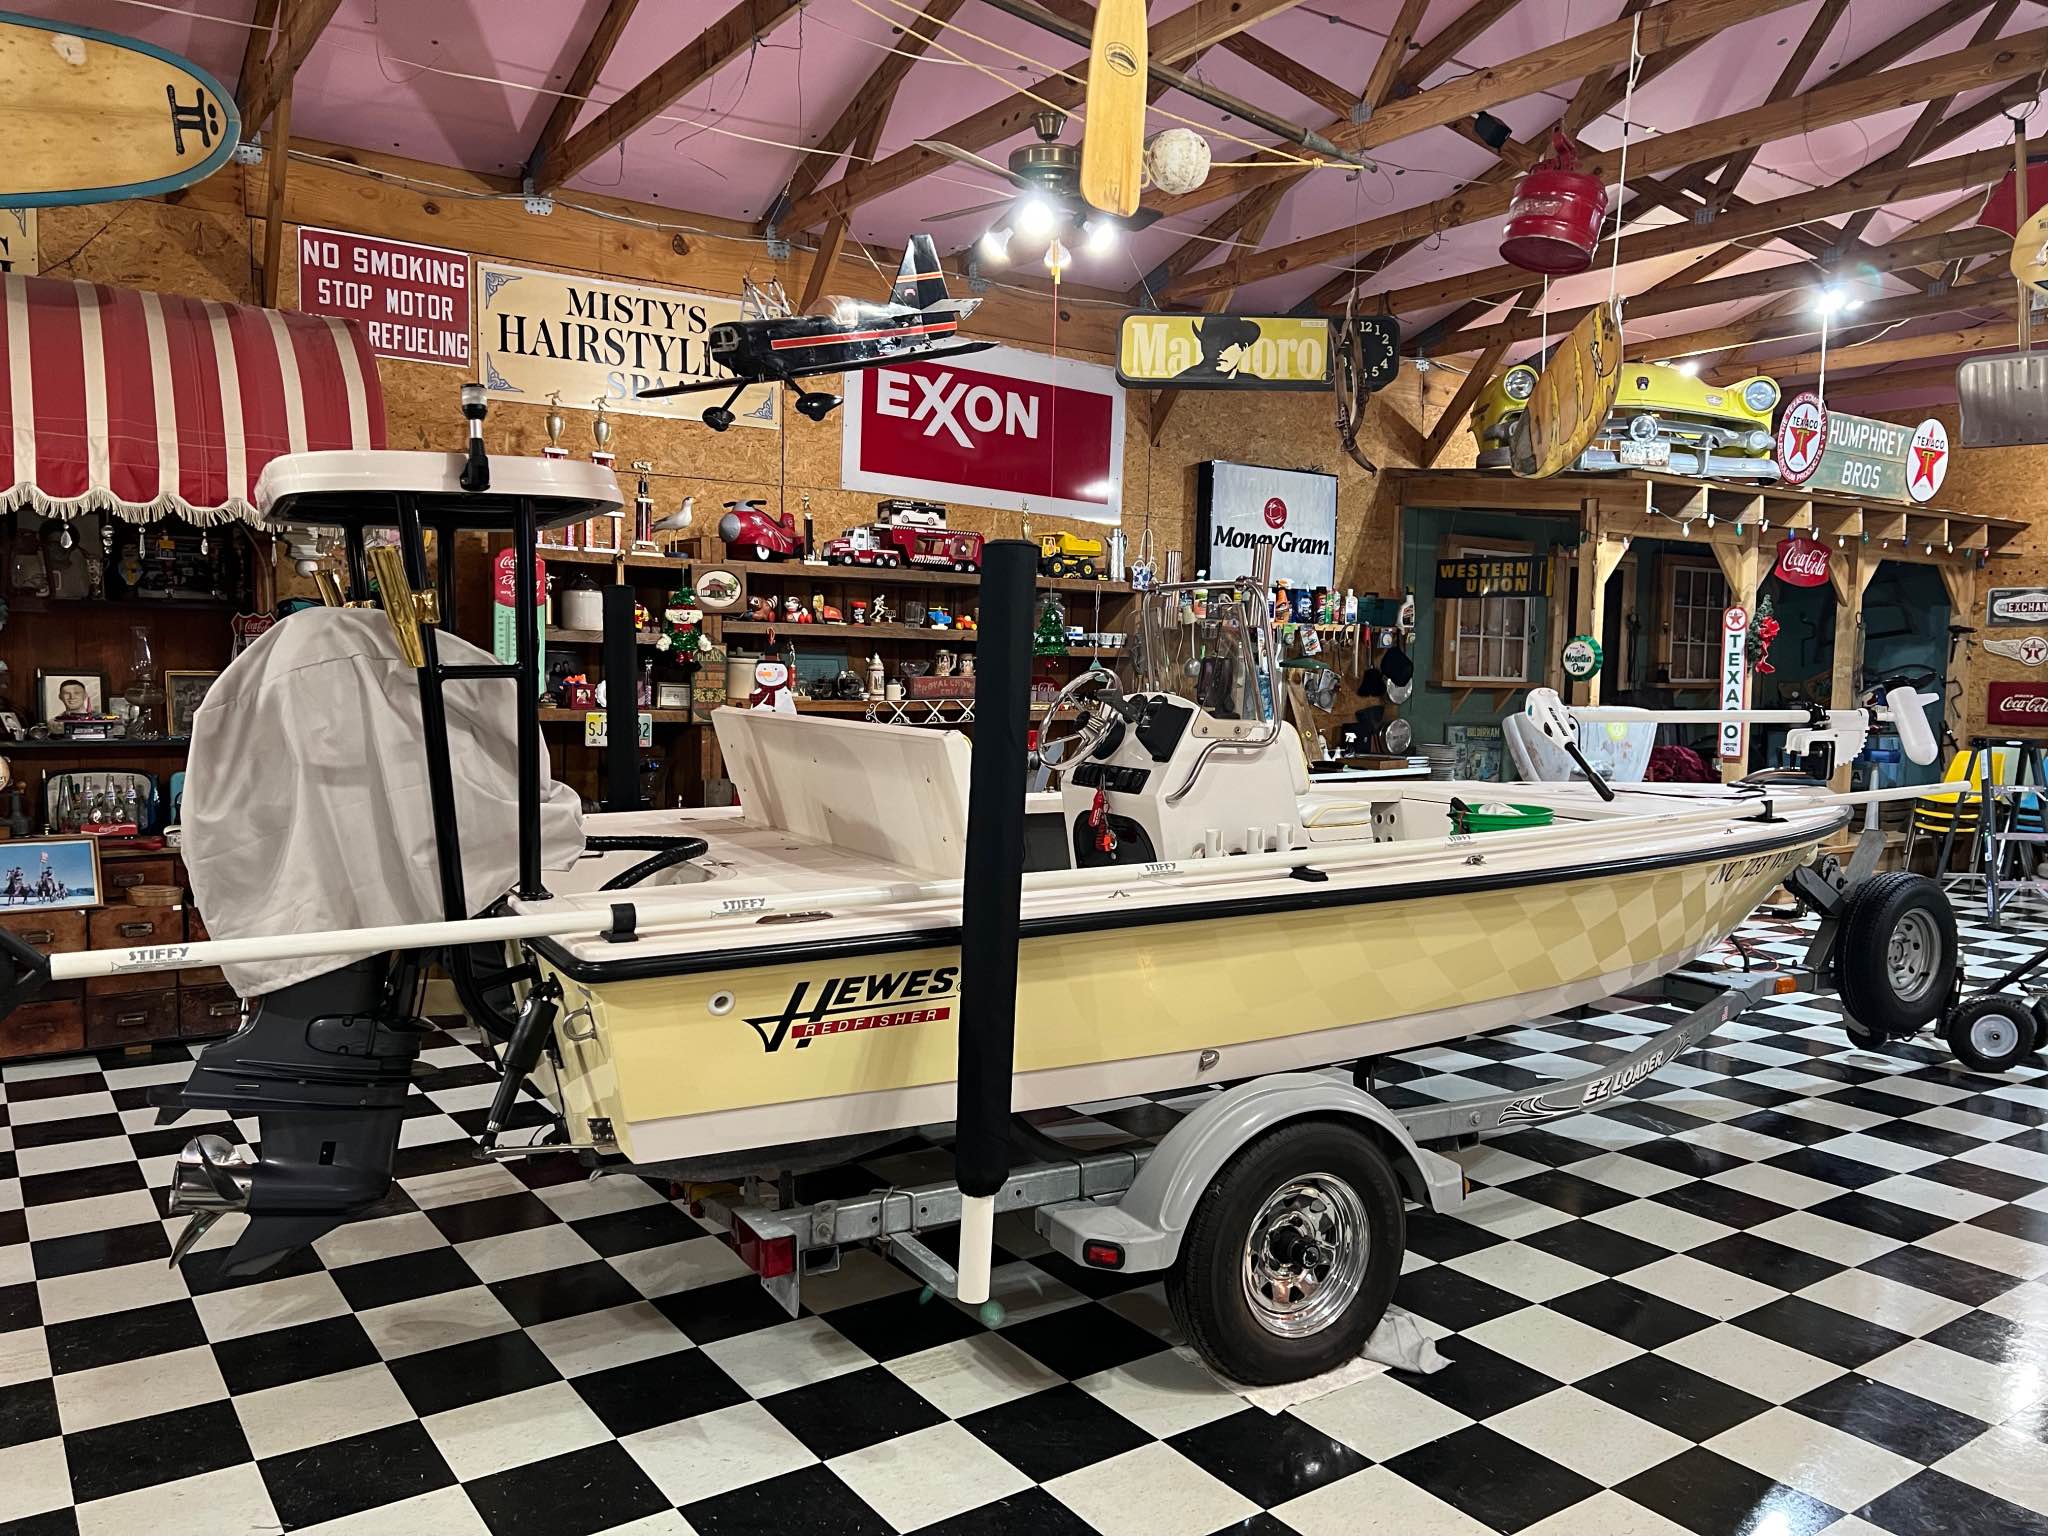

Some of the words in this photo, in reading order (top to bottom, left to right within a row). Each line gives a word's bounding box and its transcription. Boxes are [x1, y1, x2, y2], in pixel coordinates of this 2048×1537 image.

[303, 239, 340, 269] NO
[353, 247, 465, 289] SMOKING
[318, 278, 373, 310] STOP
[386, 288, 453, 322] MOTOR
[565, 287, 707, 334] MISTY'S
[1360, 321, 1373, 332] 12
[1375, 324, 1381, 336] 1
[368, 320, 469, 359] REFUELING
[1381, 333, 1390, 345] 2
[1386, 345, 1394, 357] 3
[1380, 357, 1389, 369] 4
[1371, 366, 1380, 377] 5
[876, 368, 1040, 449] EXXON
[1793, 416, 1819, 430] TEXACO
[1829, 418, 1906, 457] HUMPHREY
[1917, 435, 1945, 450] TEXACO
[1841, 460, 1882, 489] BROS
[1783, 546, 1828, 576] Coca-Cola
[1440, 562, 1529, 578] WESTERN
[1466, 577, 1529, 593] UNION
[1724, 634, 1742, 739] TEXAO
[1145, 862, 1176, 871] STIFFY
[722, 897, 766, 910] STIFFY
[128, 946, 190, 961] STIFFY
[744, 967, 959, 1053] HEWES
[804, 1009, 937, 1037] REDFISHER
[1582, 1075, 1613, 1105] EZ
[1612, 1049, 1665, 1095] LOADER
